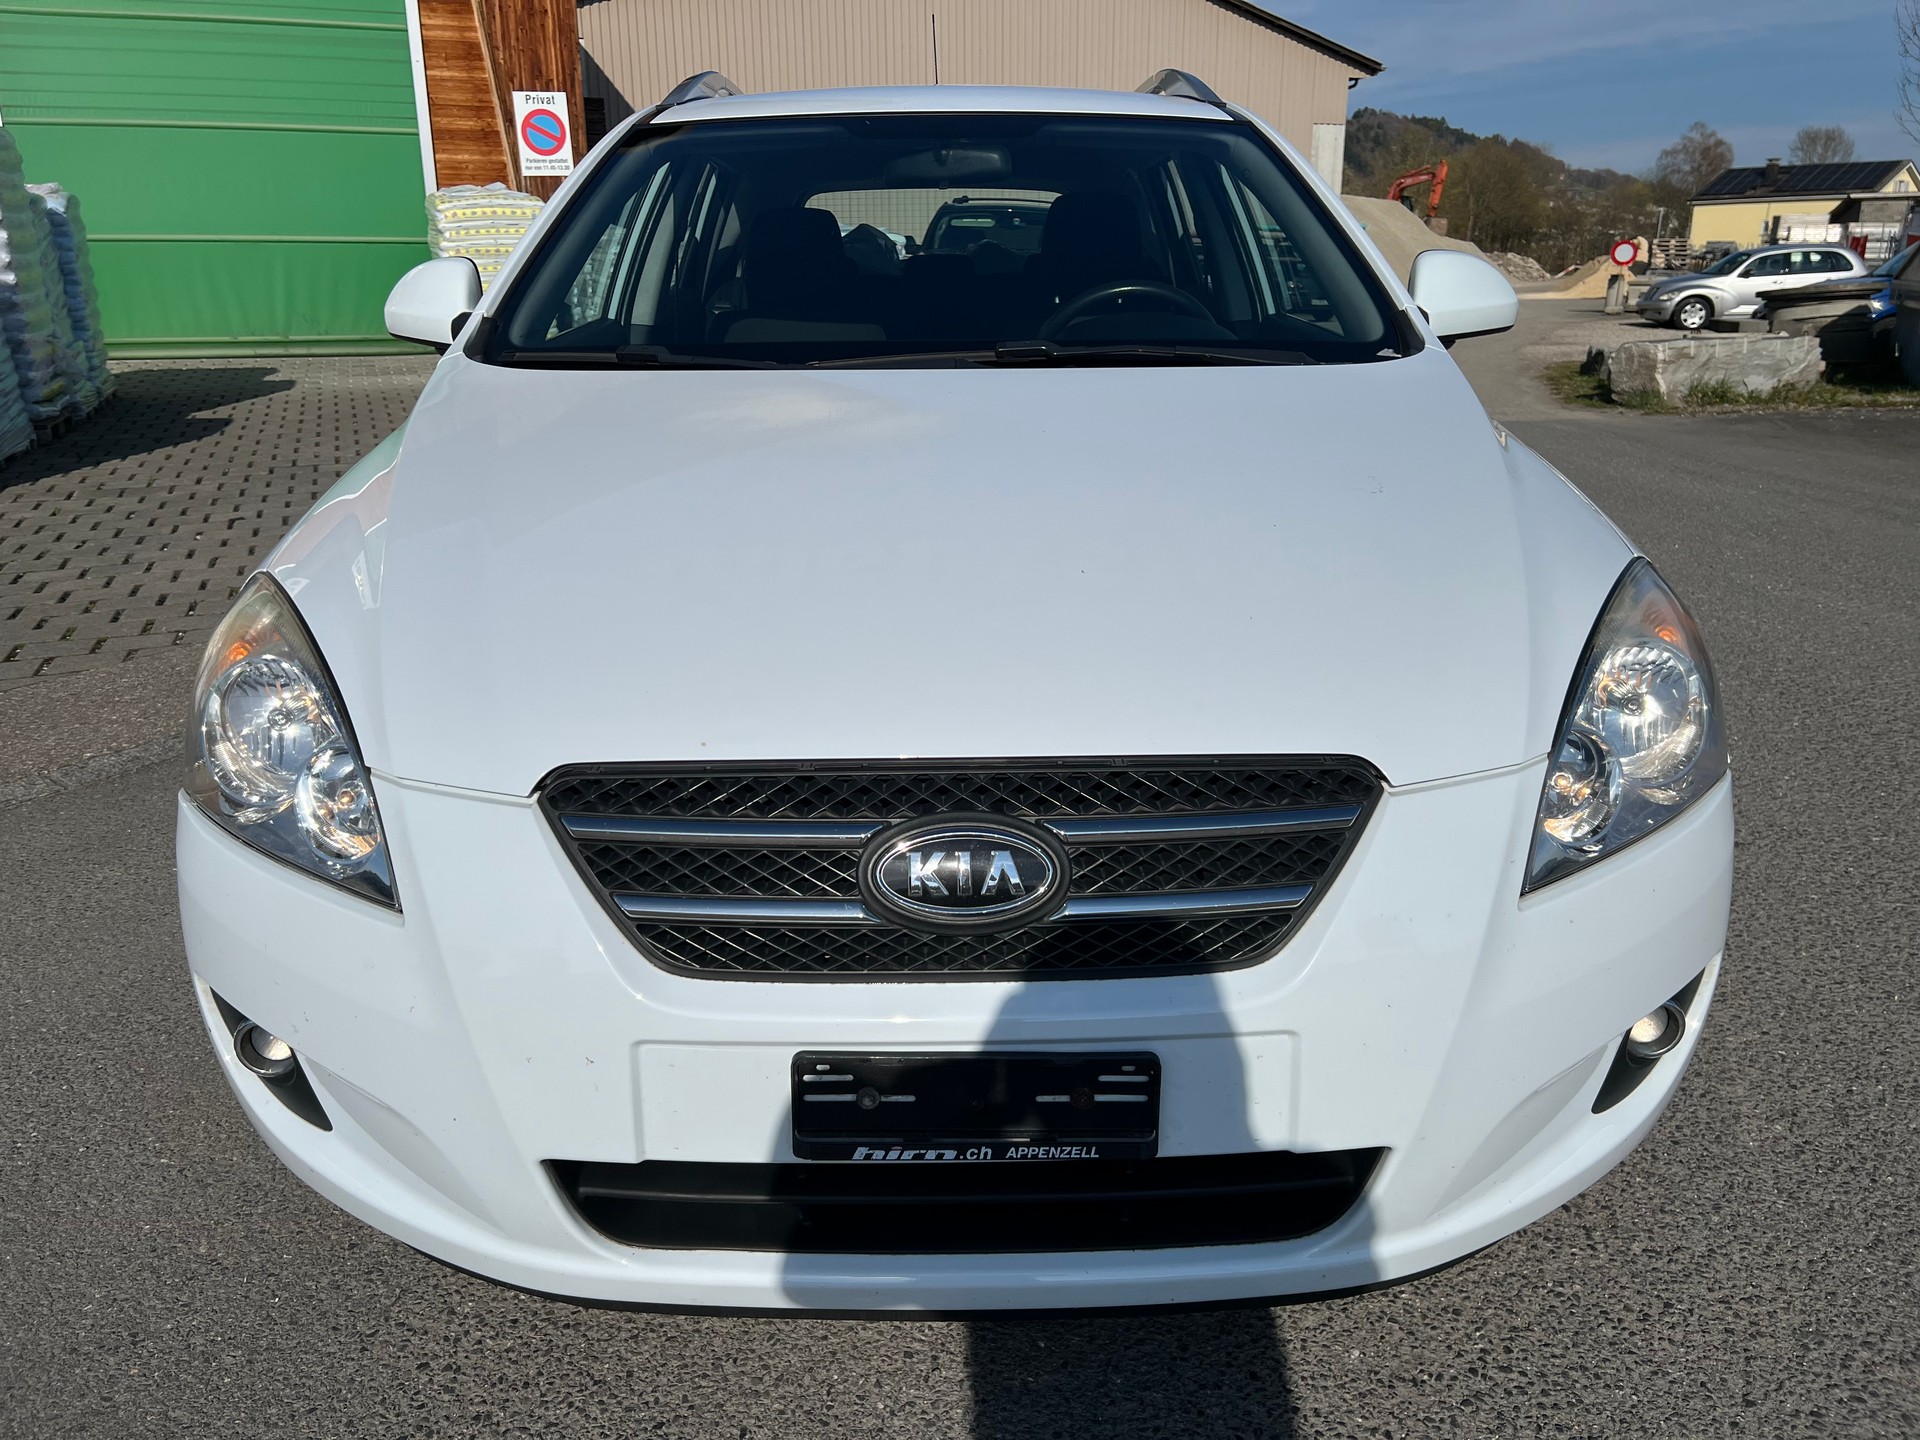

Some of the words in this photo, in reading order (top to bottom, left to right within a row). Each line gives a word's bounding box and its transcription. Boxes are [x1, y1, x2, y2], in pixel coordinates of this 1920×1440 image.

[525, 94, 555, 105] Privat
[906, 851, 1025, 896] KIA
[1005, 1146, 1100, 1159] APPENZELL
